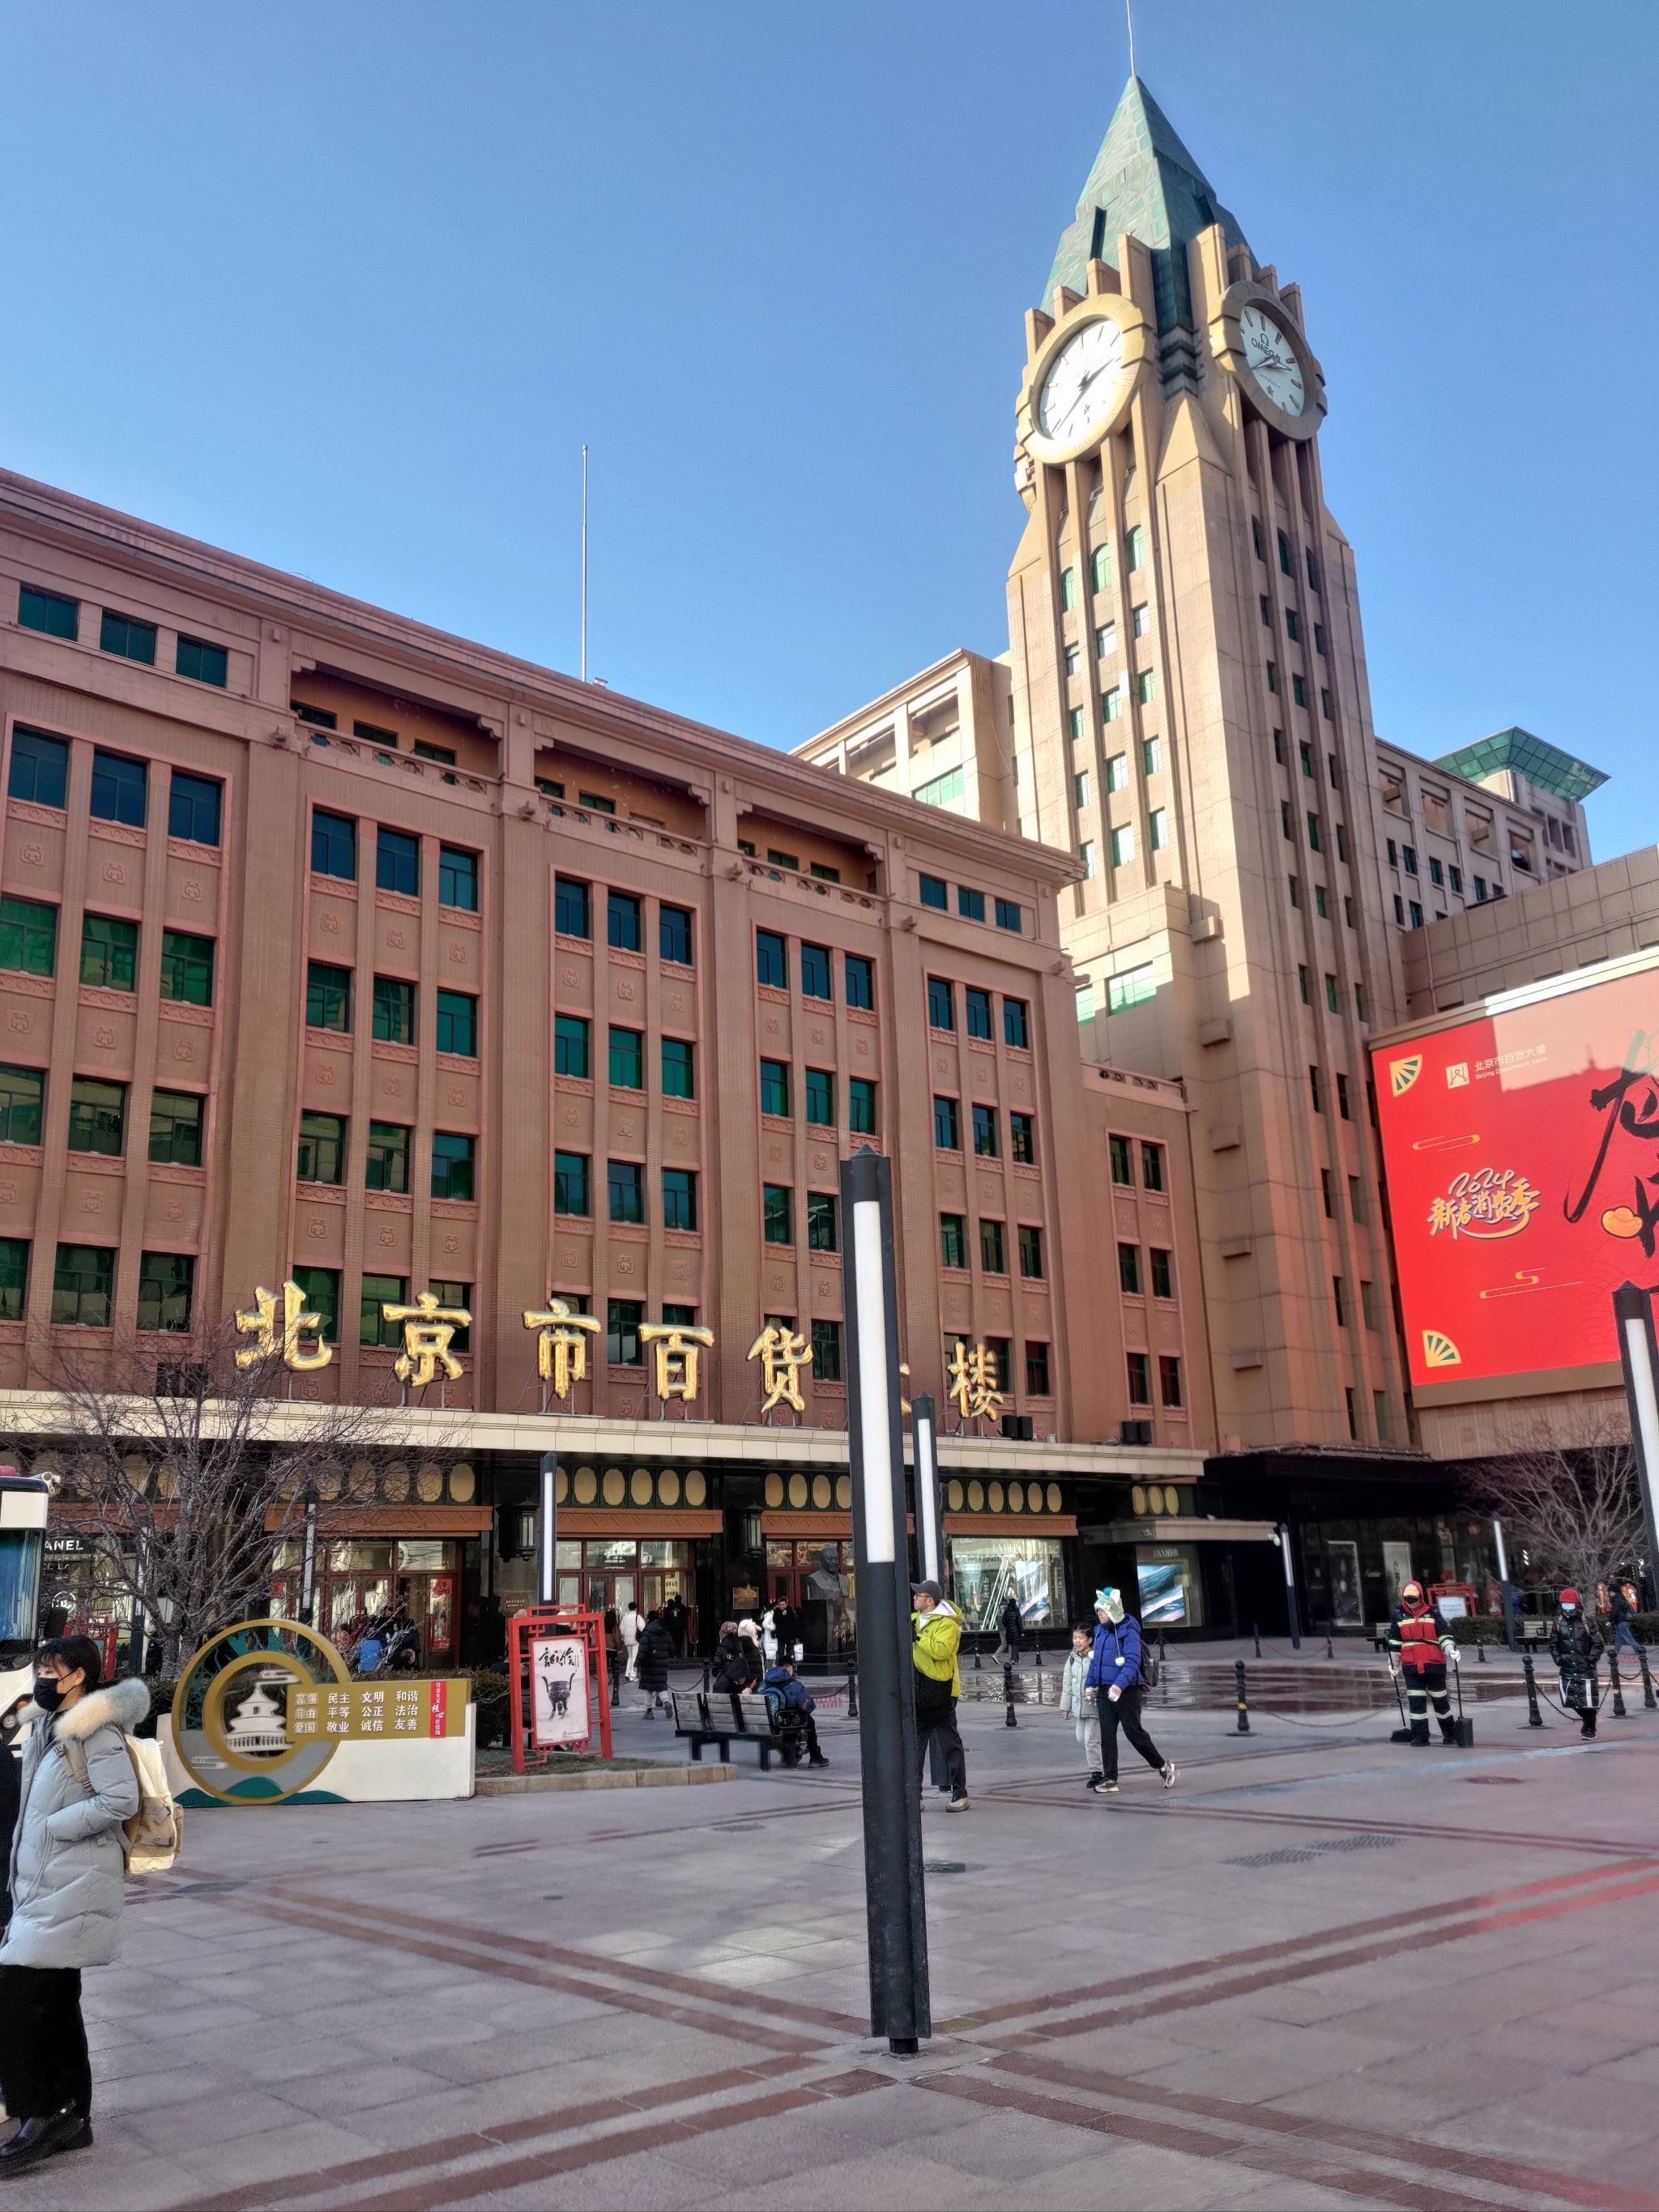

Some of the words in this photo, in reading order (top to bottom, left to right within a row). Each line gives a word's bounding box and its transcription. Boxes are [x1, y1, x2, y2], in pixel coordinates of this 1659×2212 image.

[1474, 1043, 1547, 1072] 北京市百货大楼
[1475, 1070, 1495, 1080] Beijing
[1448, 1167, 1515, 1199] 2024
[235, 1279, 1004, 1422] 北京市百货楼
[295, 1693, 318, 1705] 富强
[328, 1693, 350, 1704] 民主
[362, 1691, 385, 1703] 文明
[395, 1690, 419, 1702] 和谐
[295, 1707, 317, 1719] 自由
[327, 1707, 350, 1718] 平等
[361, 1706, 384, 1717] 公正
[394, 1705, 419, 1716] 法治
[293, 1721, 315, 1733] 爱国
[326, 1721, 349, 1733] 敬业
[360, 1720, 383, 1732] 诚信
[394, 1719, 418, 1731] 友善
